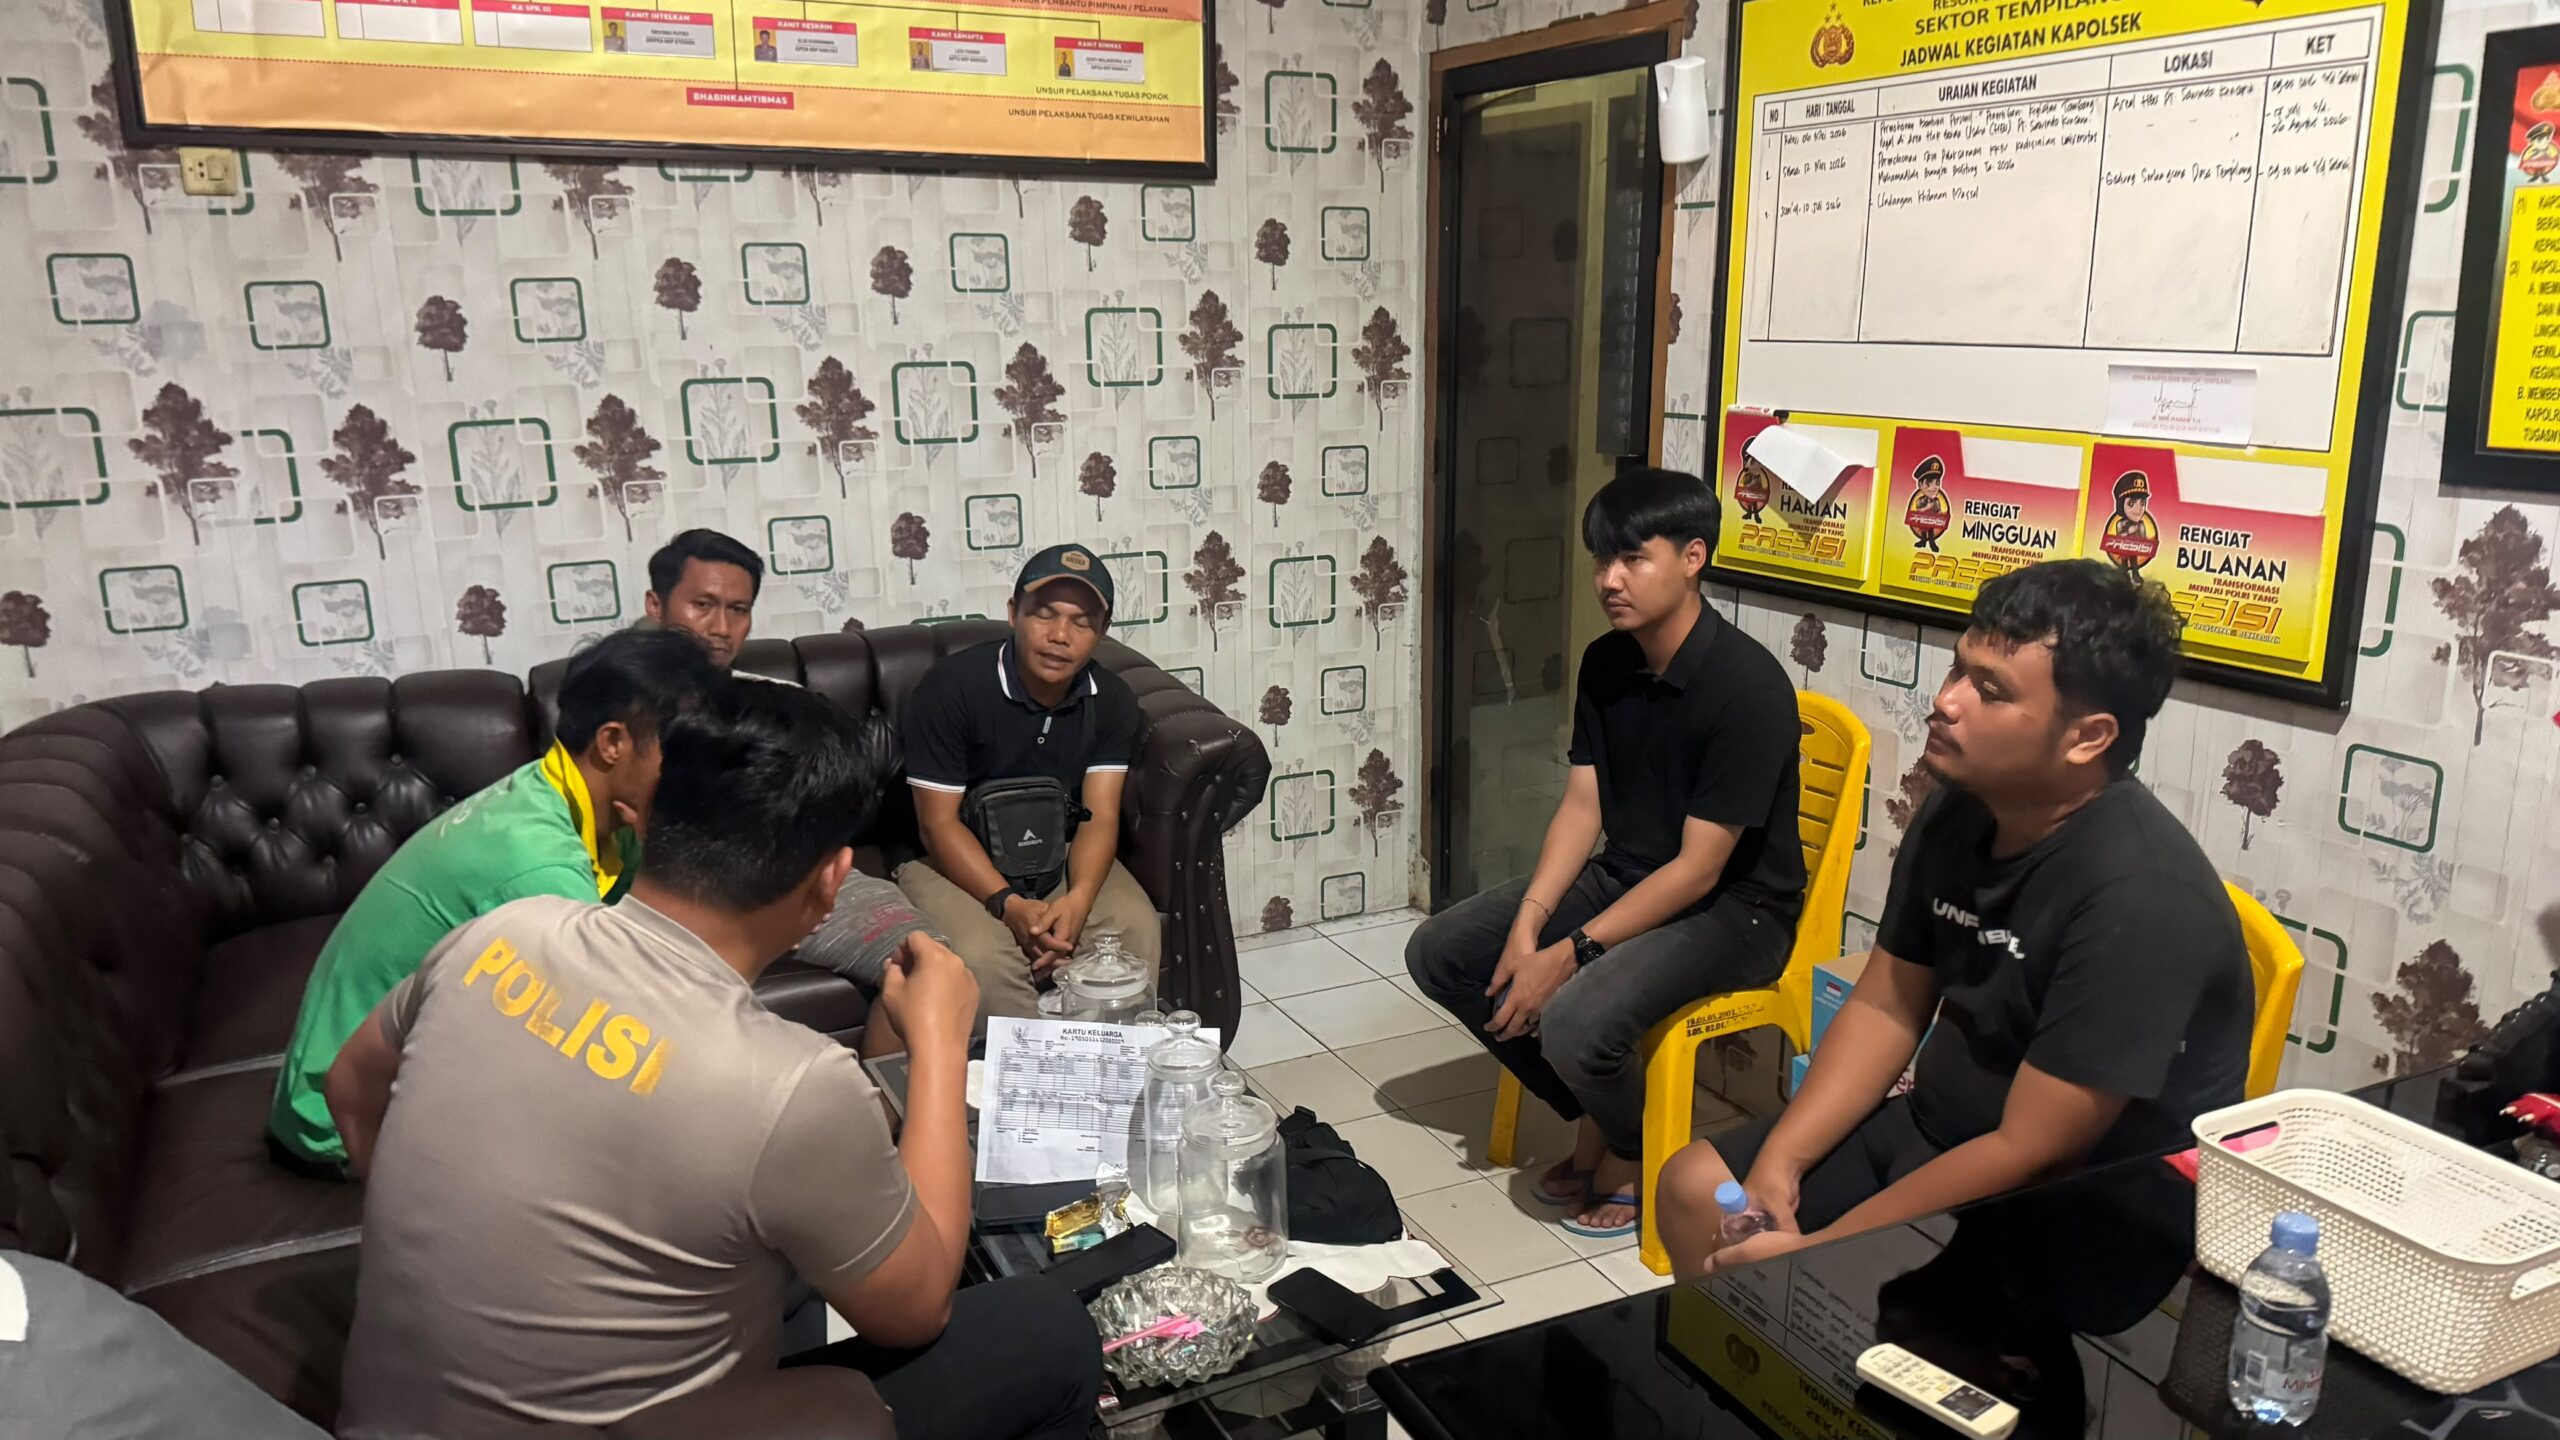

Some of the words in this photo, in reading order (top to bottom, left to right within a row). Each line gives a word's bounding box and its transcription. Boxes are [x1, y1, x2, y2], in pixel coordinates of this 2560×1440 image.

[651, 12, 690, 21] INTELKAM
[1088, 2, 1127, 10] PIMPINAN
[1134, 5, 1169, 13] PELAYAN
[1915, 8, 1990, 35] SEKTOR
[953, 32, 984, 40] SAMAPTA
[1900, 42, 1961, 68] JADWAL
[1965, 26, 2046, 57] KEGIATAN
[2050, 11, 2142, 44] KAPOLSEK
[2304, 33, 2336, 57] KET
[2163, 50, 2213, 74] LOKASI
[1036, 86, 1065, 95] UNSUR
[1066, 88, 1114, 98] PELAKSANA
[1114, 90, 1140, 99] TUGAS
[1141, 92, 1169, 100] POKOK
[1938, 81, 1979, 102] URAIAN
[1981, 74, 2037, 97] KEGIATAN
[693, 92, 788, 105] BHABINKAMTIBMAS
[1008, 109, 1037, 117] UNSUR
[1038, 110, 1086, 119] PELAKSANA
[1087, 112, 1114, 120] TUGAS
[1115, 113, 1170, 123] KEWILAYAHAN
[1769, 109, 1779, 122] NO
[1805, 104, 1821, 119] HARI
[1825, 99, 1855, 117] TANGGAL
[1829, 128, 1847, 139] 2026
[1780, 494, 1847, 520] HARIAN
[1964, 500, 2021, 520] RENGIAT
[1803, 517, 1845, 530] TRANSFORMASI
[1827, 528, 1845, 537] YANG
[1738, 523, 1847, 561] PRESISI
[1962, 520, 2057, 549] MINGGUAN
[2180, 526, 2251, 550] RENGIAT
[1972, 551, 1999, 561] MENUJU
[2000, 555, 2020, 564] POLRI
[1990, 545, 2044, 559] TRANSFORMASI
[2176, 547, 2287, 583] BULANAN
[2188, 583, 2224, 596] MENUJU
[2225, 588, 2250, 600] POLRI
[2252, 593, 2279, 605] YANG
[2212, 577, 2281, 595] TRANSFORMASI
[462, 936, 676, 1096] POLISI
[1062, 1028, 1087, 1036] KARTU
[1088, 1029, 1123, 1038] KELUARGA
